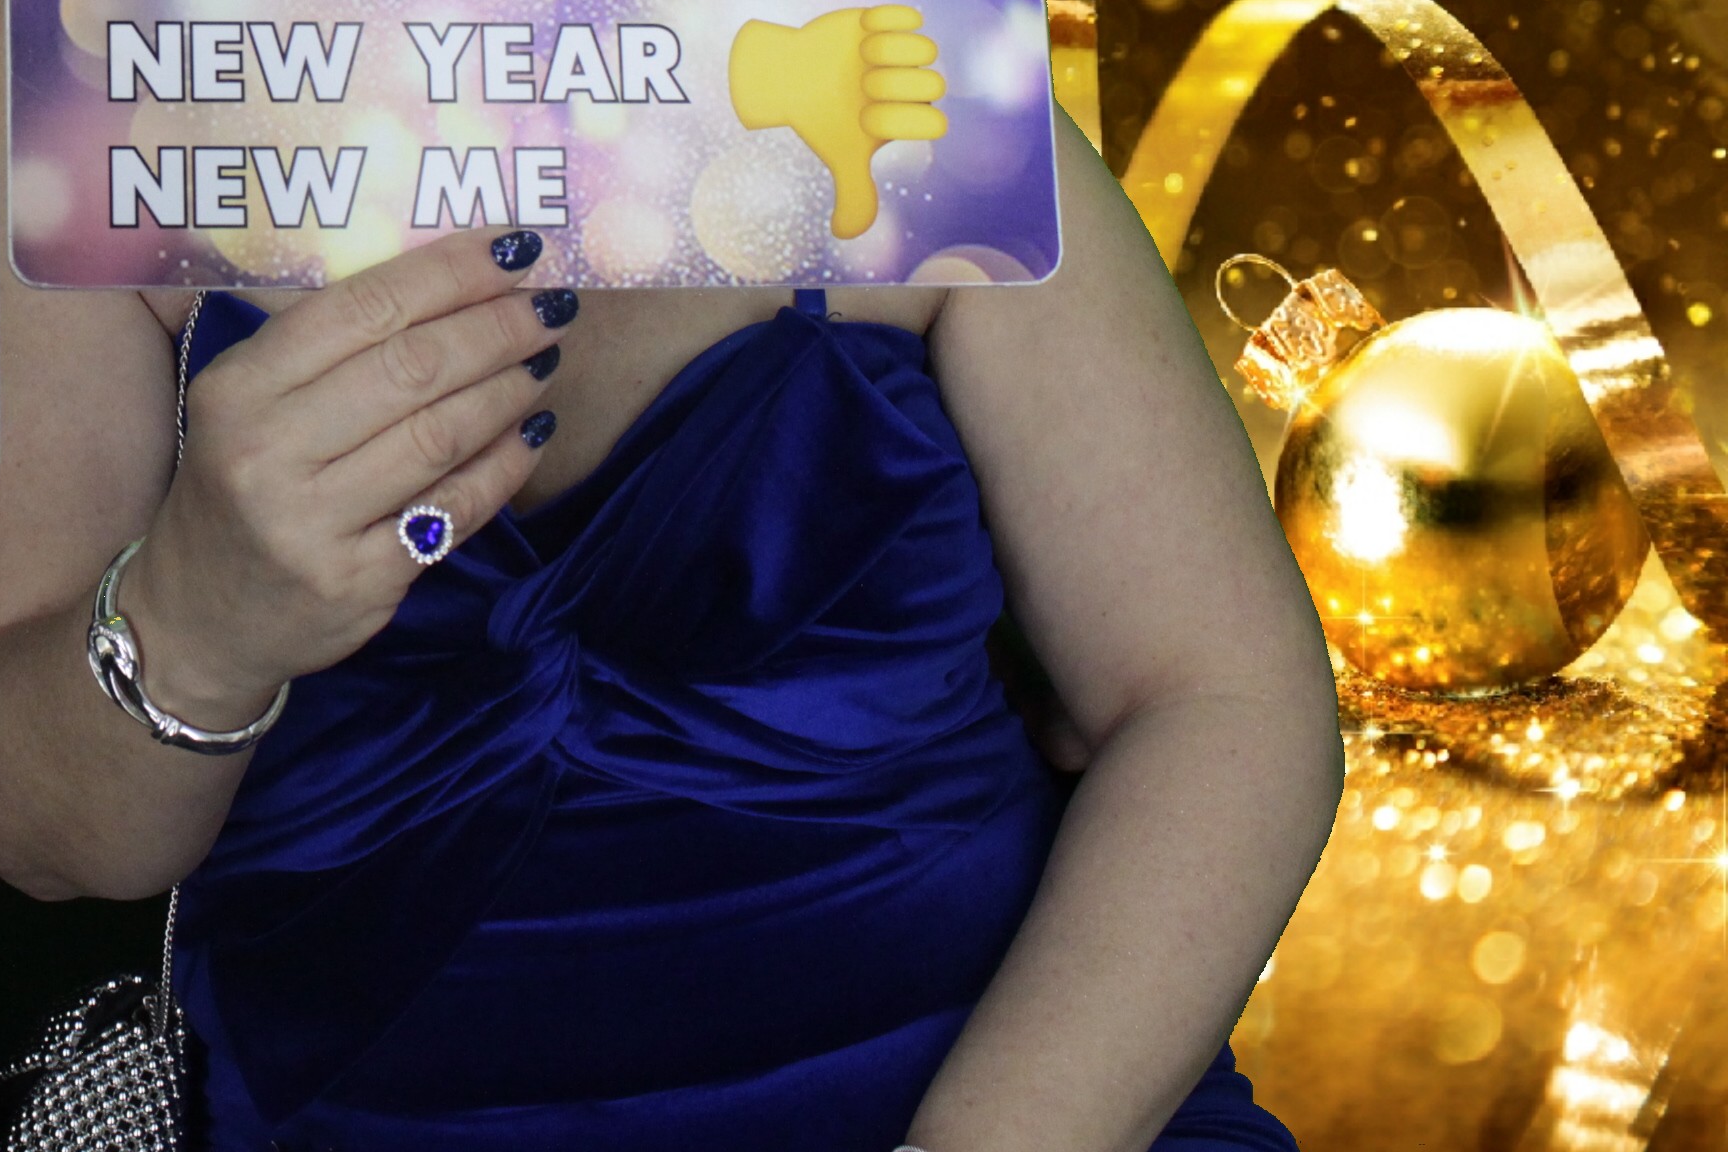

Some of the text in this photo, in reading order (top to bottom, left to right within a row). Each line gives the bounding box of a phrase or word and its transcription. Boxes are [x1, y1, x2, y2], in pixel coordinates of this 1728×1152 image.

[107, 19, 690, 105] NEW YEAR
[108, 145, 570, 230] NEW ME
